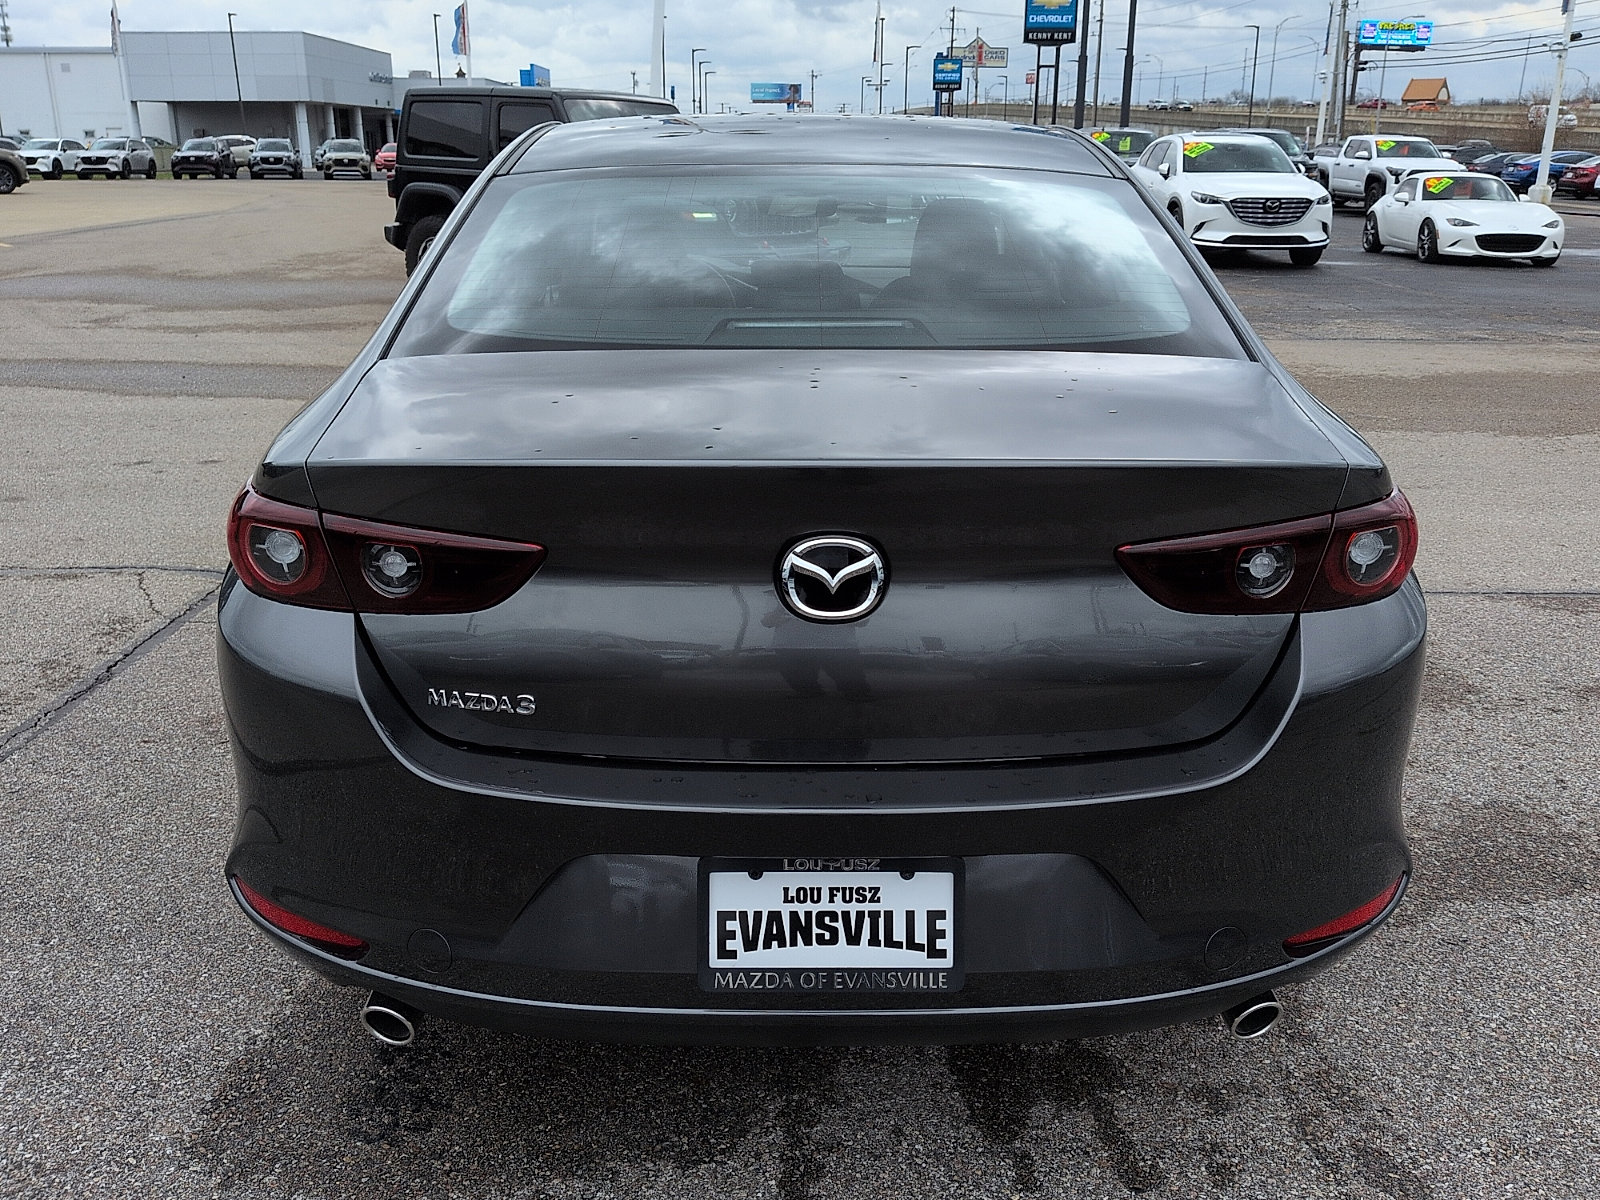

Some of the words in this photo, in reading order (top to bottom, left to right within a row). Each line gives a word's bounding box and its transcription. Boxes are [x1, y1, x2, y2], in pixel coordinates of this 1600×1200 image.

[1029, 14, 1073, 23] CHEVROLET
[1028, 32, 1051, 40] KENNY
[1053, 32, 1072, 40] KENT
[427, 688, 536, 715] MAZDA3
[783, 859, 822, 871] LOU
[782, 886, 823, 904] LOU
[827, 886, 881, 904] FUSZ
[716, 909, 948, 960] EVANSVILLE
[714, 971, 795, 989] MAZDA
[800, 971, 828, 989] OF
[834, 971, 948, 989] EVANSVILLE
